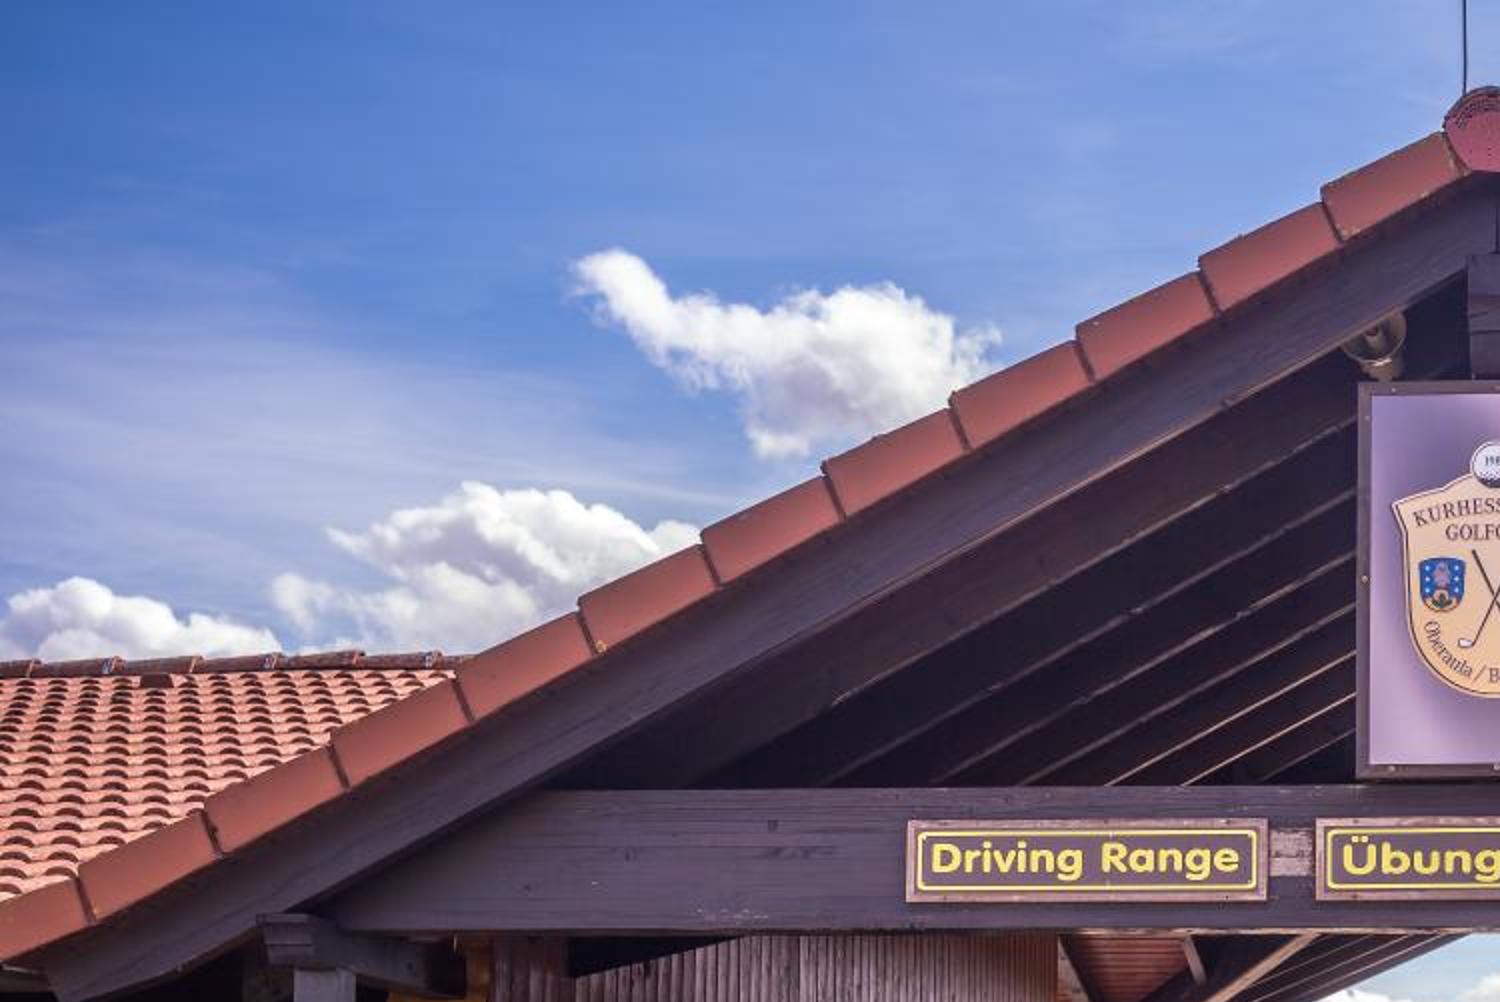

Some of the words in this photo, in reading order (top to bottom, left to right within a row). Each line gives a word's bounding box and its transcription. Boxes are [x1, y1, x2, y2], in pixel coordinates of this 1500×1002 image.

[1423, 620, 1473, 678] Oberaula
[930, 841, 1084, 882] Driving
[1100, 842, 1241, 882] Range
